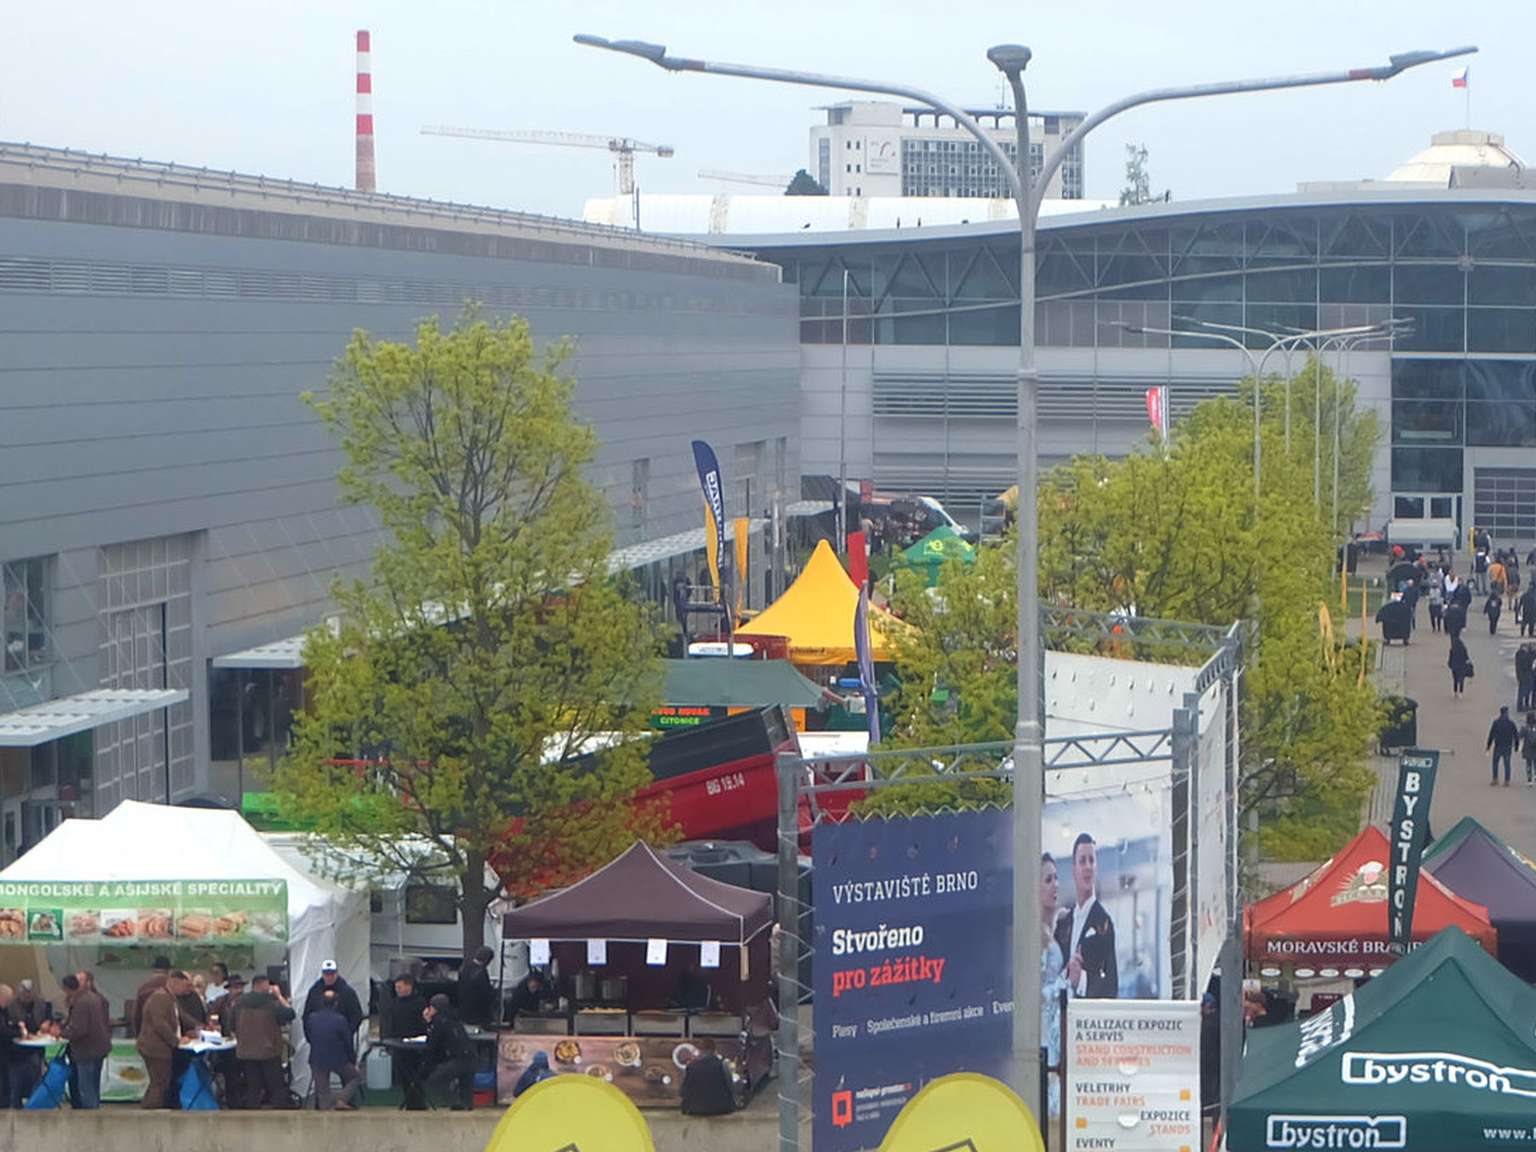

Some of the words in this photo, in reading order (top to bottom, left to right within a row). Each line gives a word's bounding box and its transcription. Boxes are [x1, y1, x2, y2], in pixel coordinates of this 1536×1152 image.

[187, 882, 283, 897] SPECIALITY
[832, 873, 930, 904] VÝSTAVIŠTĚ
[936, 870, 978, 894] BRNO
[832, 923, 924, 955] Stvořeno
[1267, 938, 1359, 954] MORAVSKÉ
[832, 967, 866, 998] pro
[870, 954, 945, 987] zážitky
[1076, 1019, 1134, 1031] REALIZACE
[1137, 1019, 1184, 1031] EXPOZIC
[1075, 1031, 1083, 1041] A
[1086, 1031, 1124, 1042] SERVIS
[1076, 1044, 1111, 1055] STAND
[1075, 1082, 1131, 1093] VELETRHY
[1076, 1096, 1110, 1106] TRADE
[1140, 1110, 1191, 1121] EXPOZICE
[1149, 1125, 1192, 1136] STANDS
[1076, 1138, 1116, 1149] EVENTY
